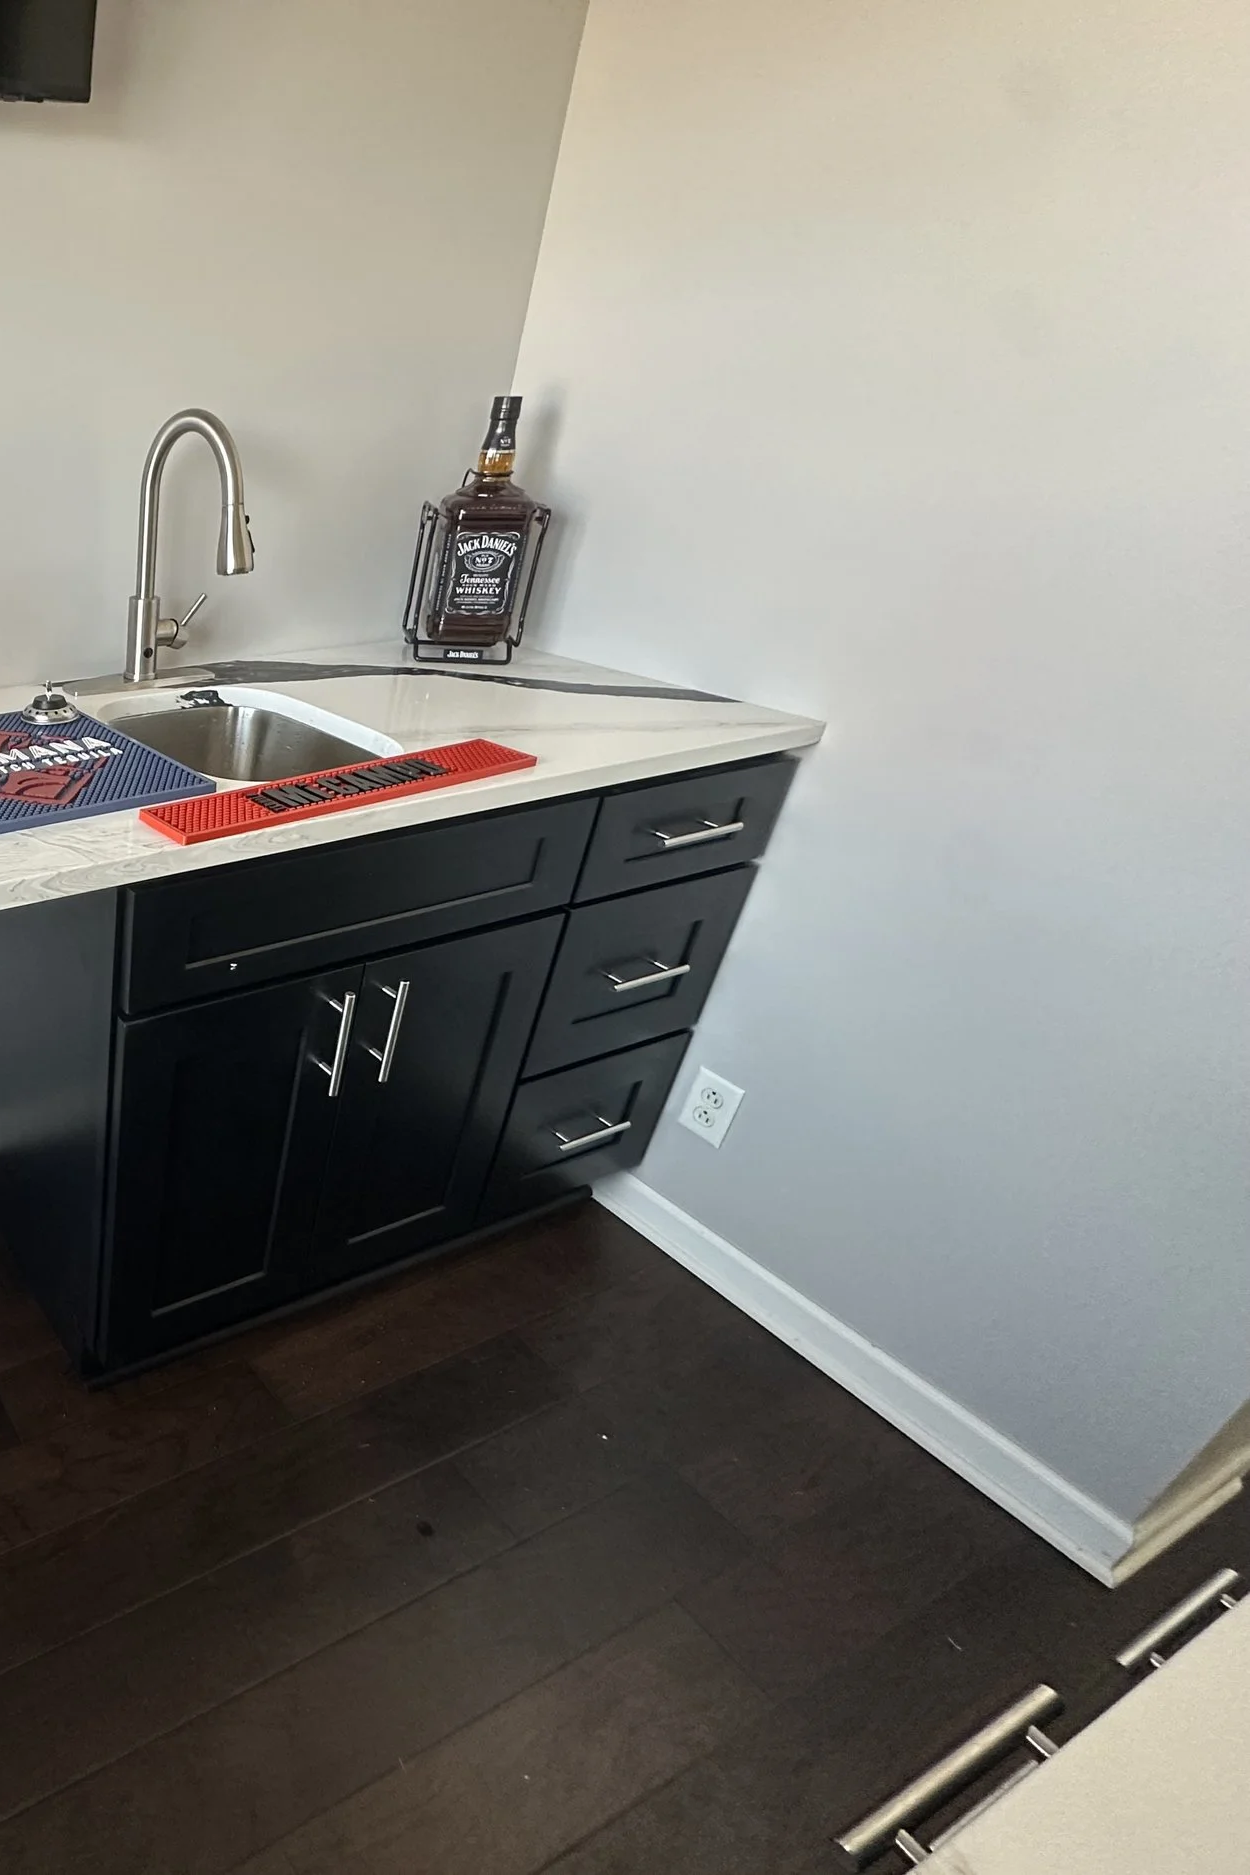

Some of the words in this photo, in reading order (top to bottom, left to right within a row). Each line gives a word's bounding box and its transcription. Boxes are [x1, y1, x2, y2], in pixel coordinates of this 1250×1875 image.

[457, 538, 481, 557] JACK
[481, 535, 517, 557] DANIEL'S
[459, 573, 501, 584] Tennessee
[455, 586, 502, 595] WHISKEY
[41, 747, 125, 767] TEQUILA
[315, 757, 449, 797] CAMPO
